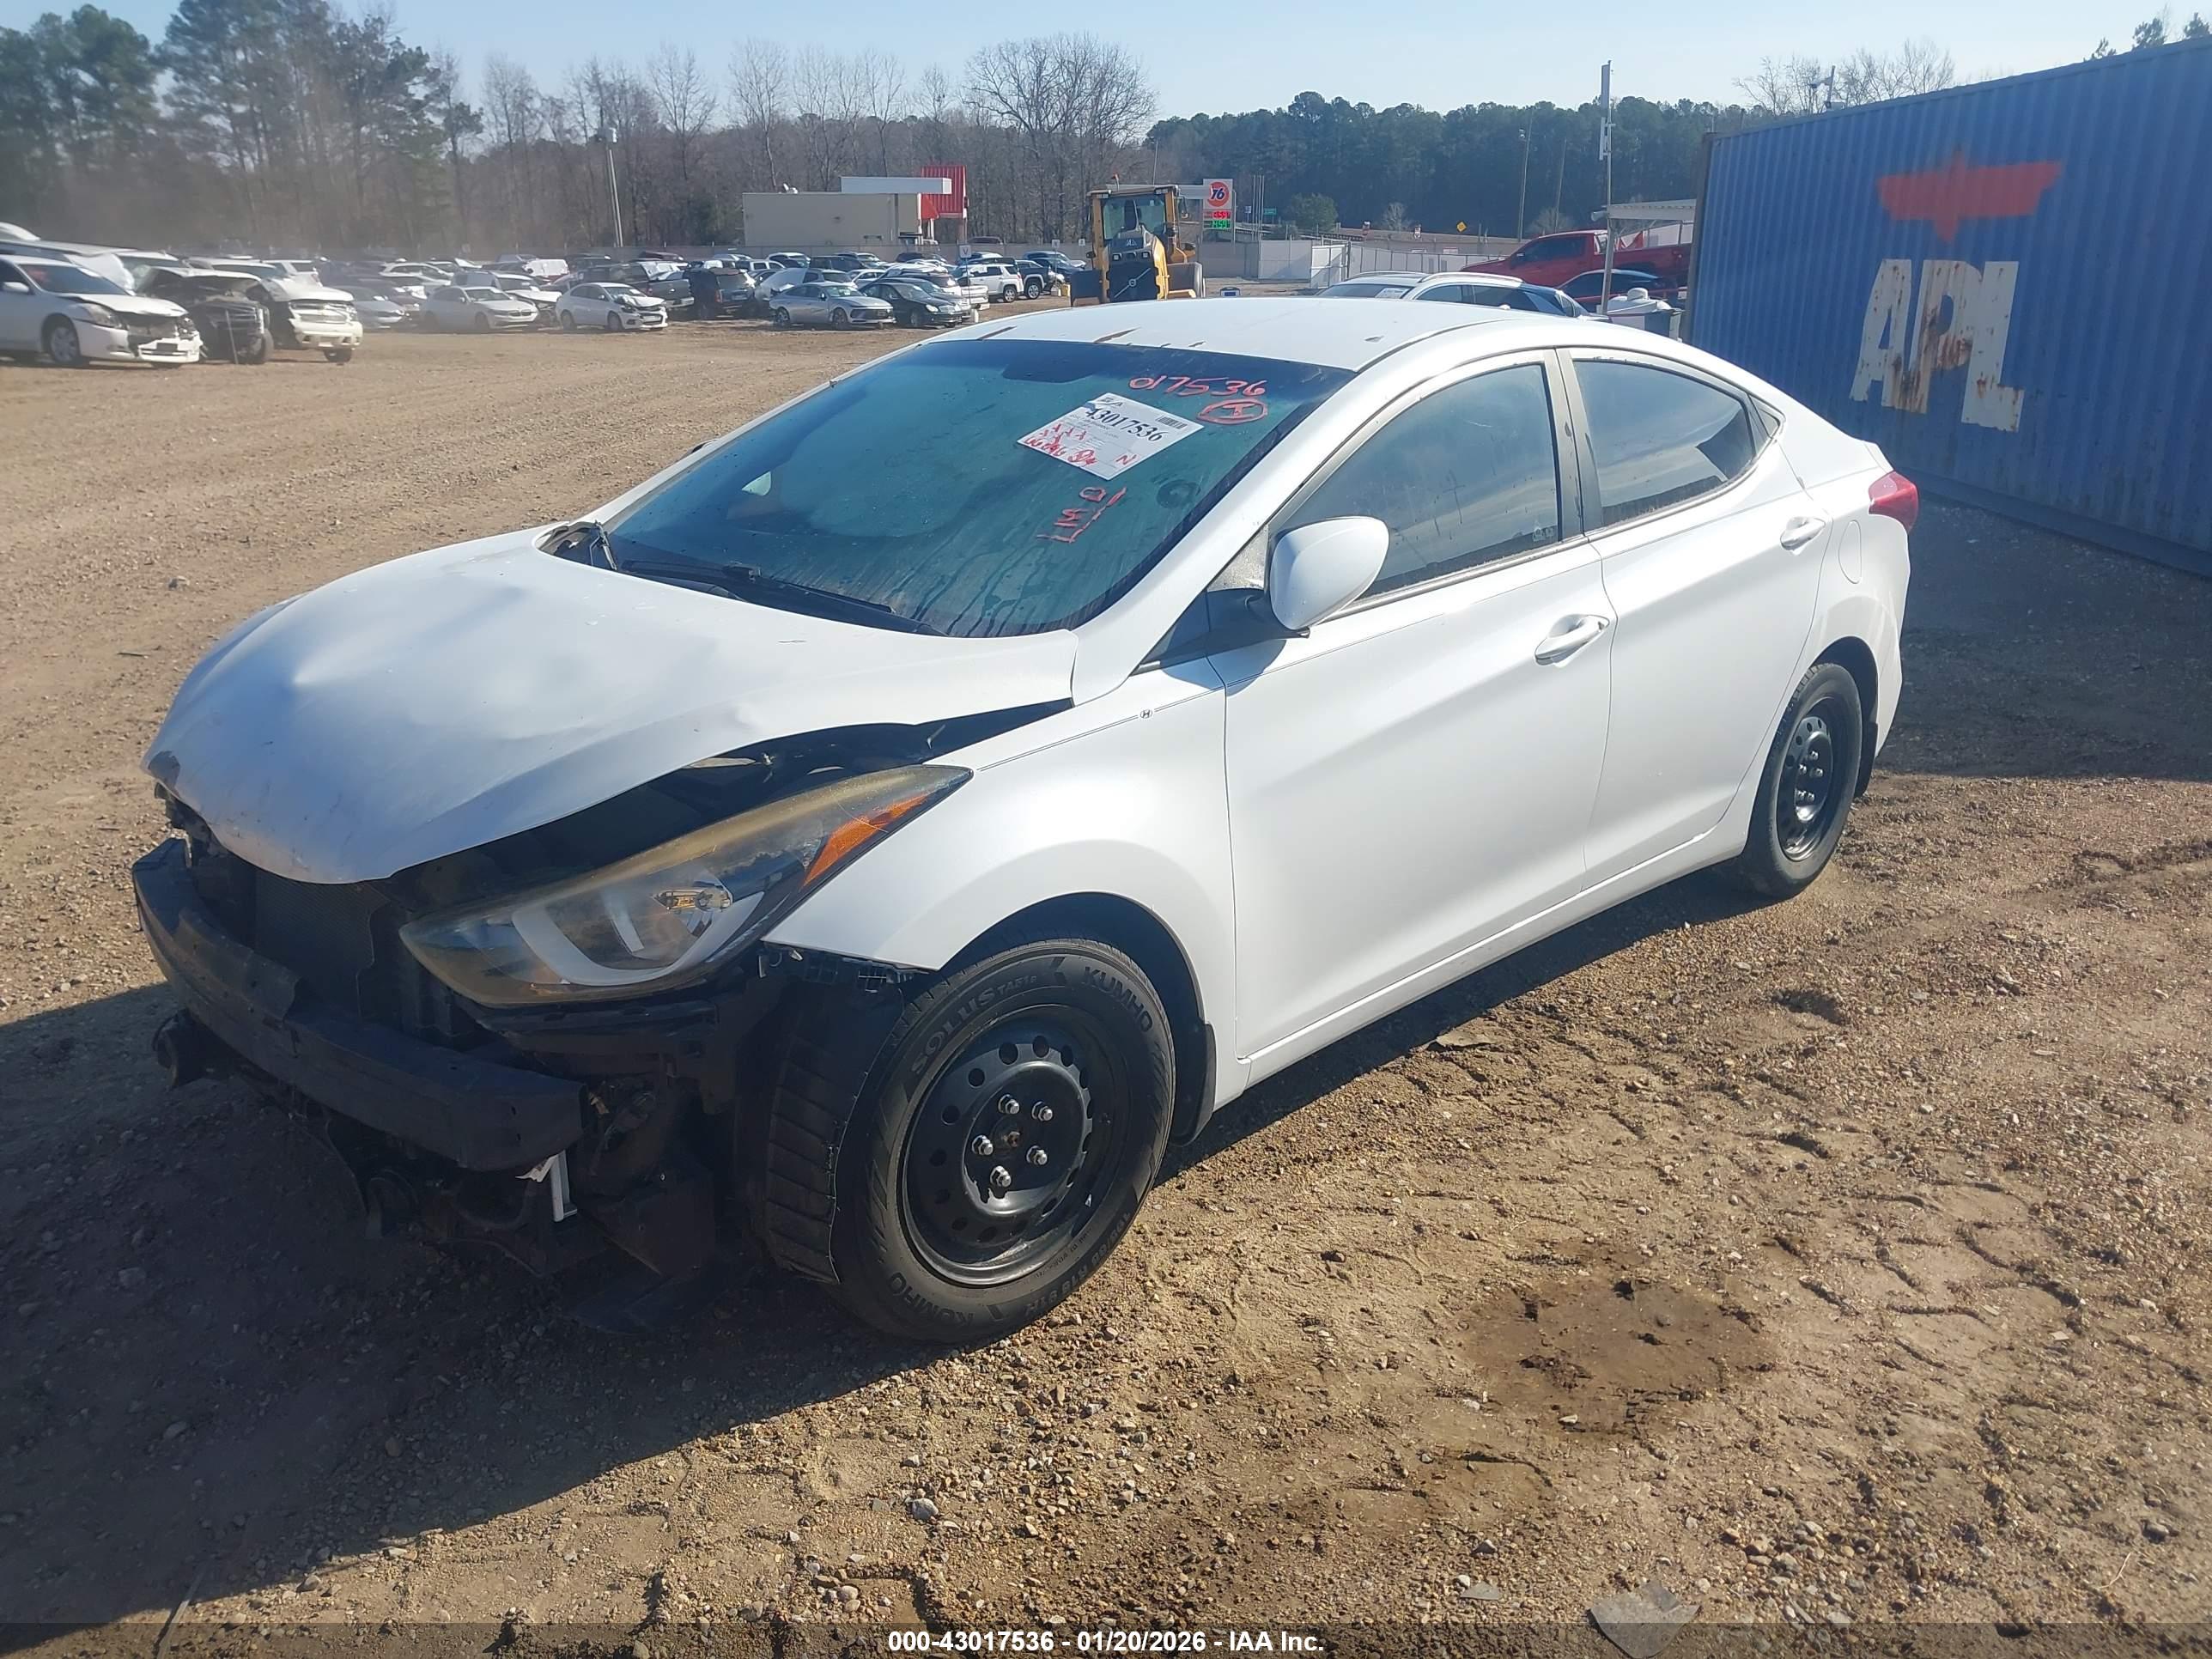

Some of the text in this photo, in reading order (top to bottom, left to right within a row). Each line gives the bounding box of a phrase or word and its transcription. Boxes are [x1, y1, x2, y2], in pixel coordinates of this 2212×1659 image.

[1210, 188, 1225, 200] 76
[1850, 259, 2025, 432] APL
[1128, 375, 1267, 396] 017536
[1085, 408, 1168, 441] 43017536
[1084, 965, 1153, 1032] KUMHO
[911, 987, 995, 1074] SOLUS
[887, 1272, 975, 1325] KUMHO
